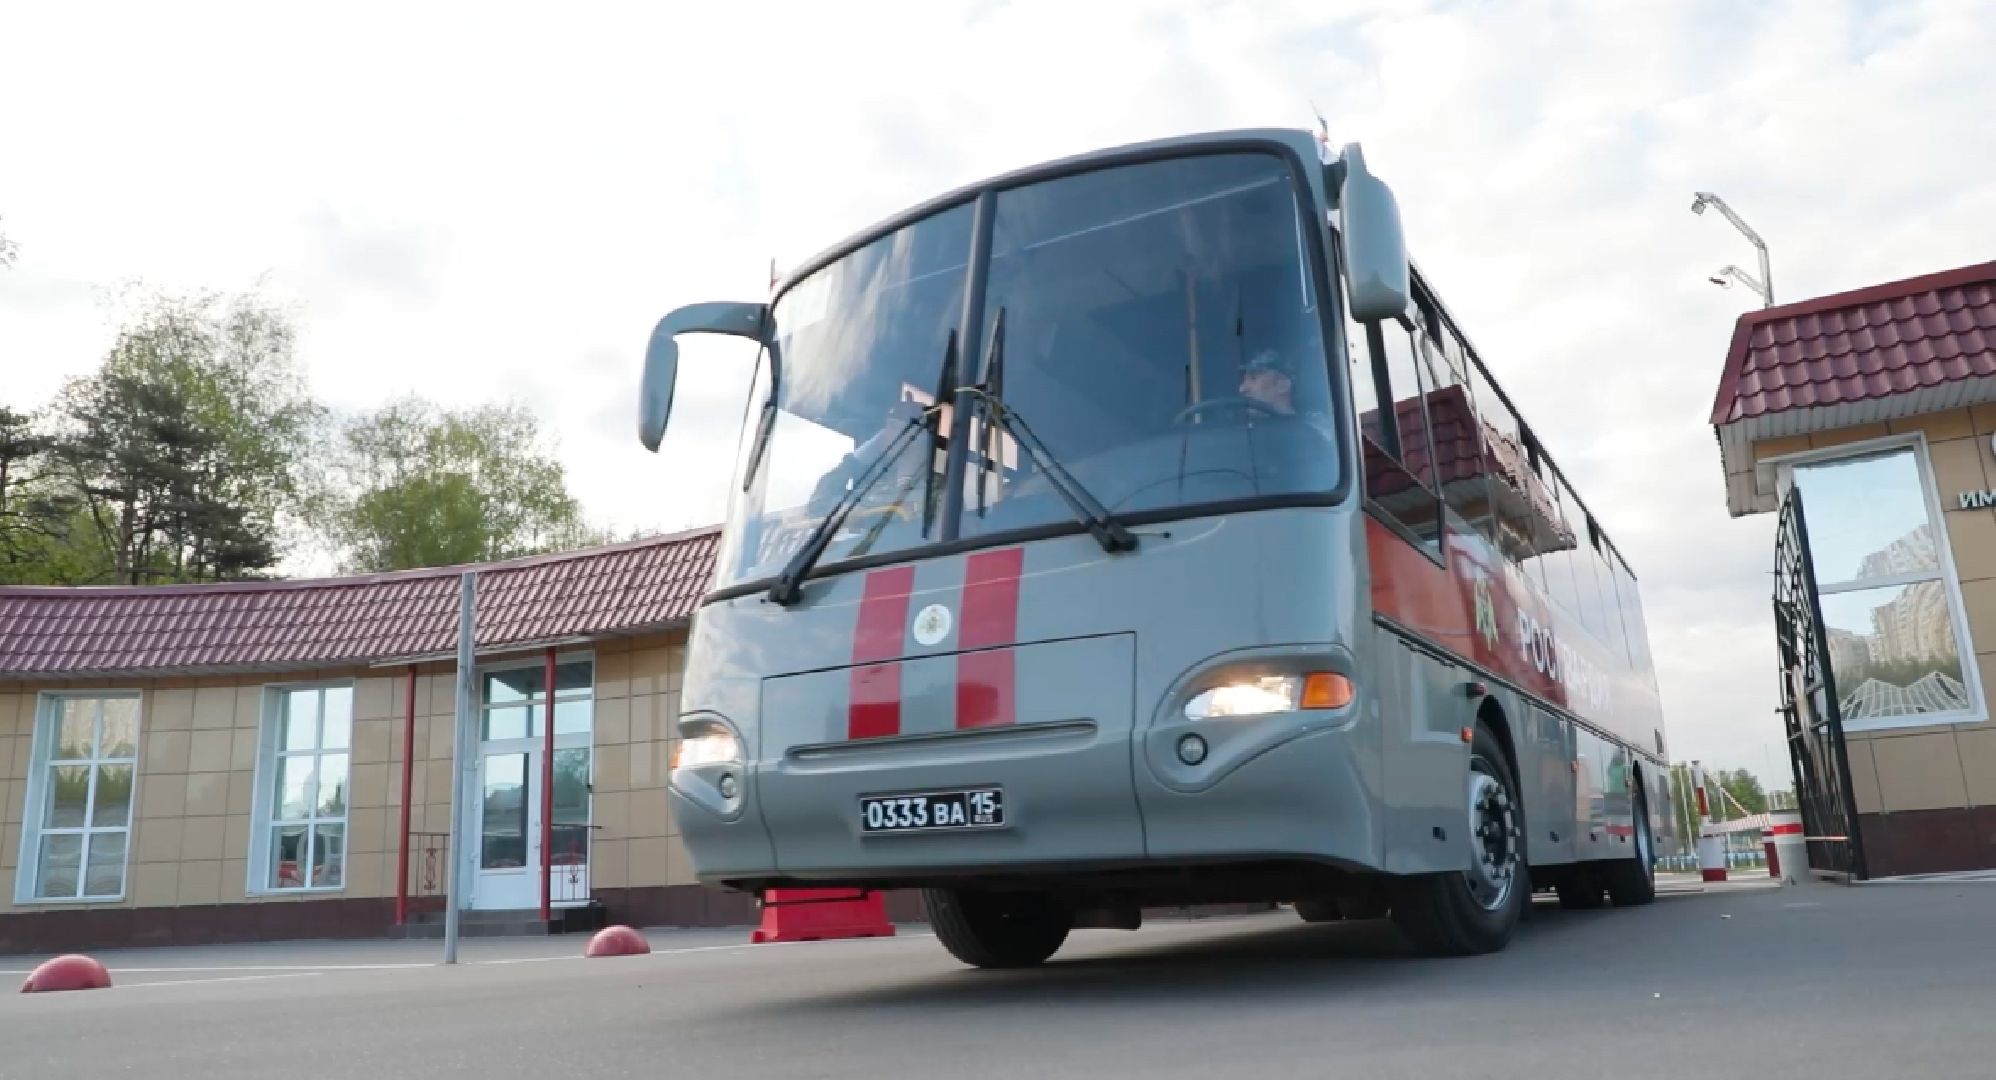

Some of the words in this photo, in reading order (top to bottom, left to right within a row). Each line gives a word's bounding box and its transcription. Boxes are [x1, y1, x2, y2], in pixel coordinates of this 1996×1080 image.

[867, 797, 928, 828] 0333
[933, 801, 965, 825] ВА
[970, 792, 994, 815] 15
